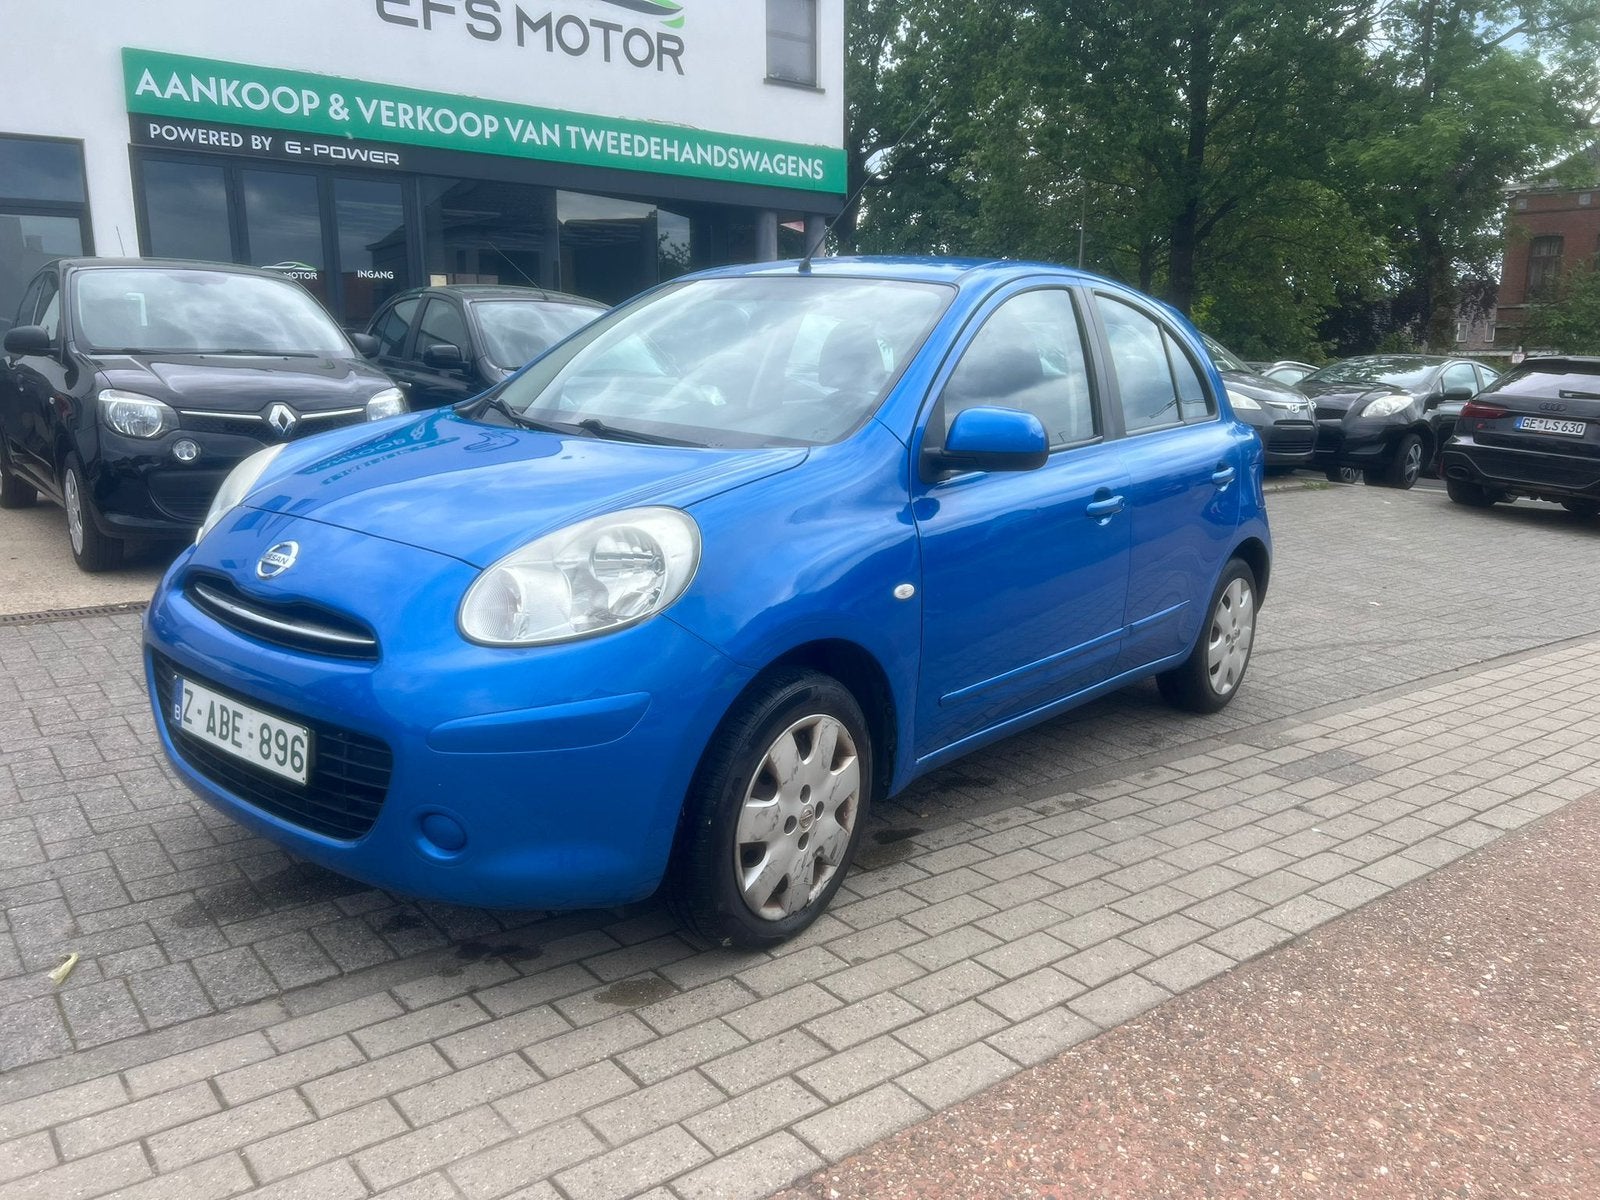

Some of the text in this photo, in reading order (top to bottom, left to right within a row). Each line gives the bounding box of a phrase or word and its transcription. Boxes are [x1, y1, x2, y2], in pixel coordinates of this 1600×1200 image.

[376, 0, 685, 76] EFS MOTOR
[135, 68, 824, 180] AANKOOP & VERKOOP VAN TWEEDEHANDSWAGENS
[149, 123, 400, 165] POWERED BY G-POWER
[357, 269, 394, 280] INGANG
[1561, 422, 1584, 434] 630
[174, 703, 182, 721] B
